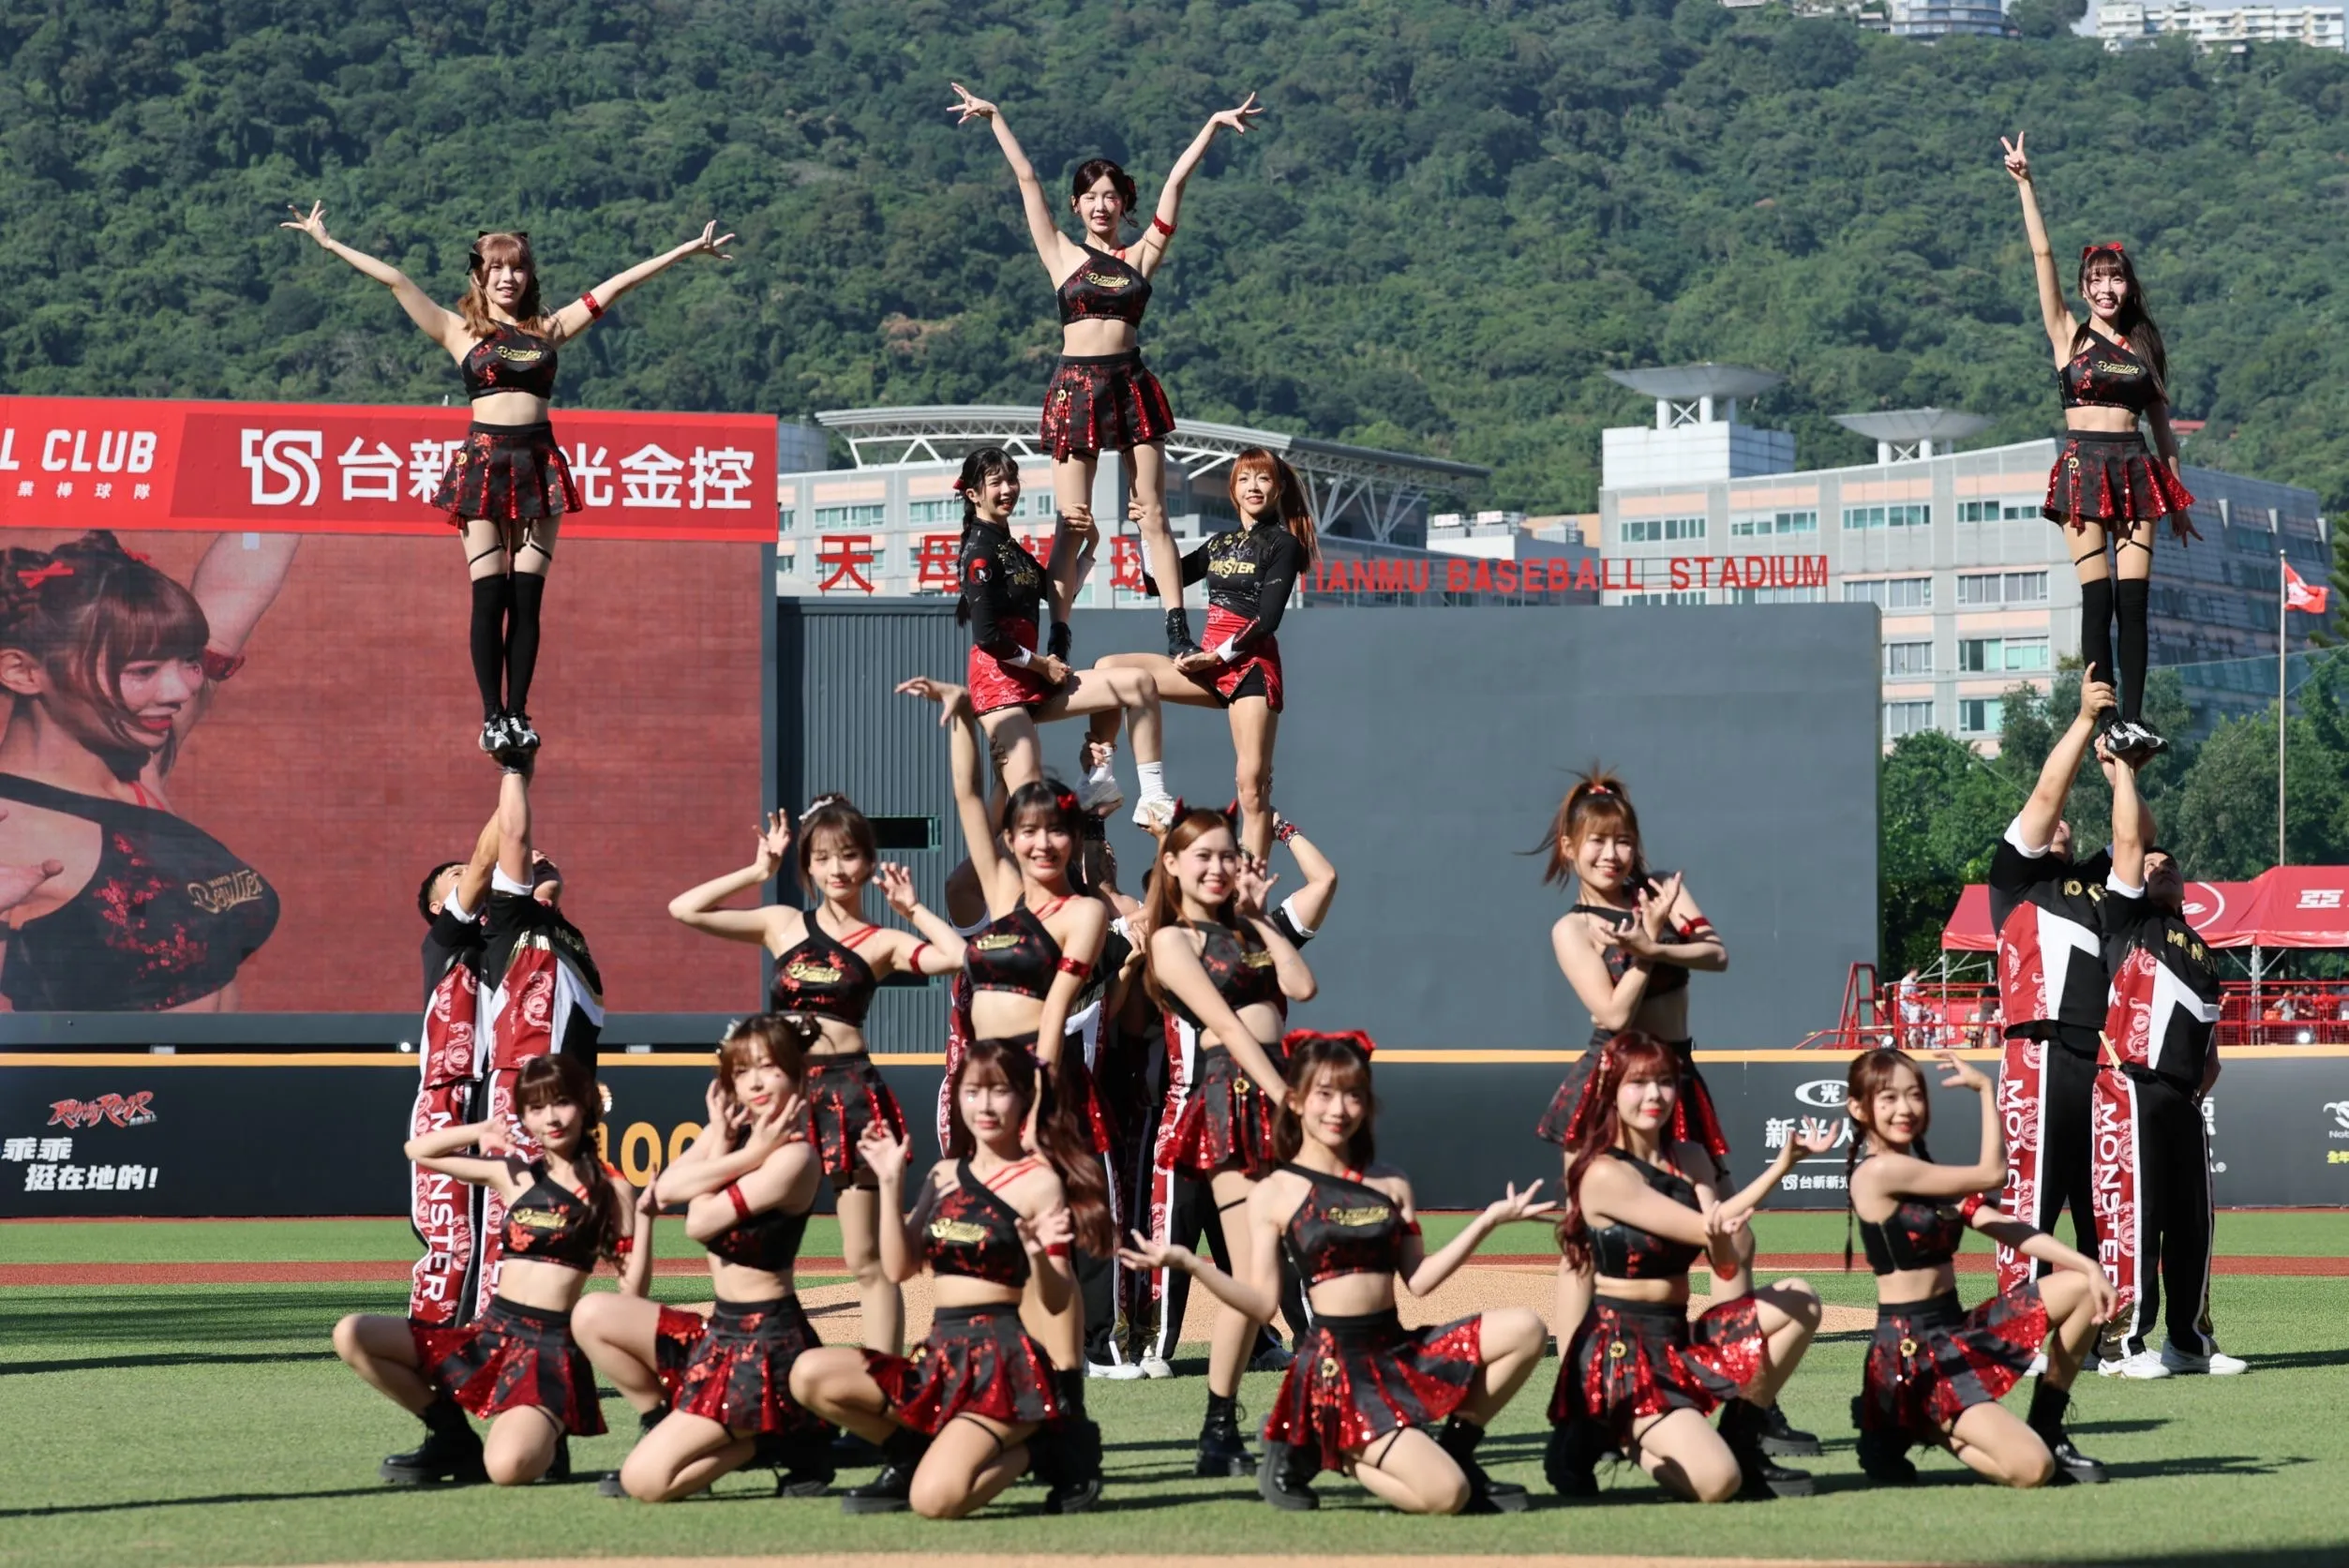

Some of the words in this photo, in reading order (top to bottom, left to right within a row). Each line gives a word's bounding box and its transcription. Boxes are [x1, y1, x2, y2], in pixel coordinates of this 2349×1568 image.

[41, 428, 157, 473] CLUB
[337, 436, 754, 509] 台新光金控
[1300, 559, 1429, 593] IANMU
[1446, 558, 1644, 593] BASEBALL
[1669, 555, 1827, 590] STADIUM
[1, 1136, 73, 1161] 乖乖
[24, 1163, 158, 1191] 挺在地的!
[422, 1112, 455, 1303] MNSTER
